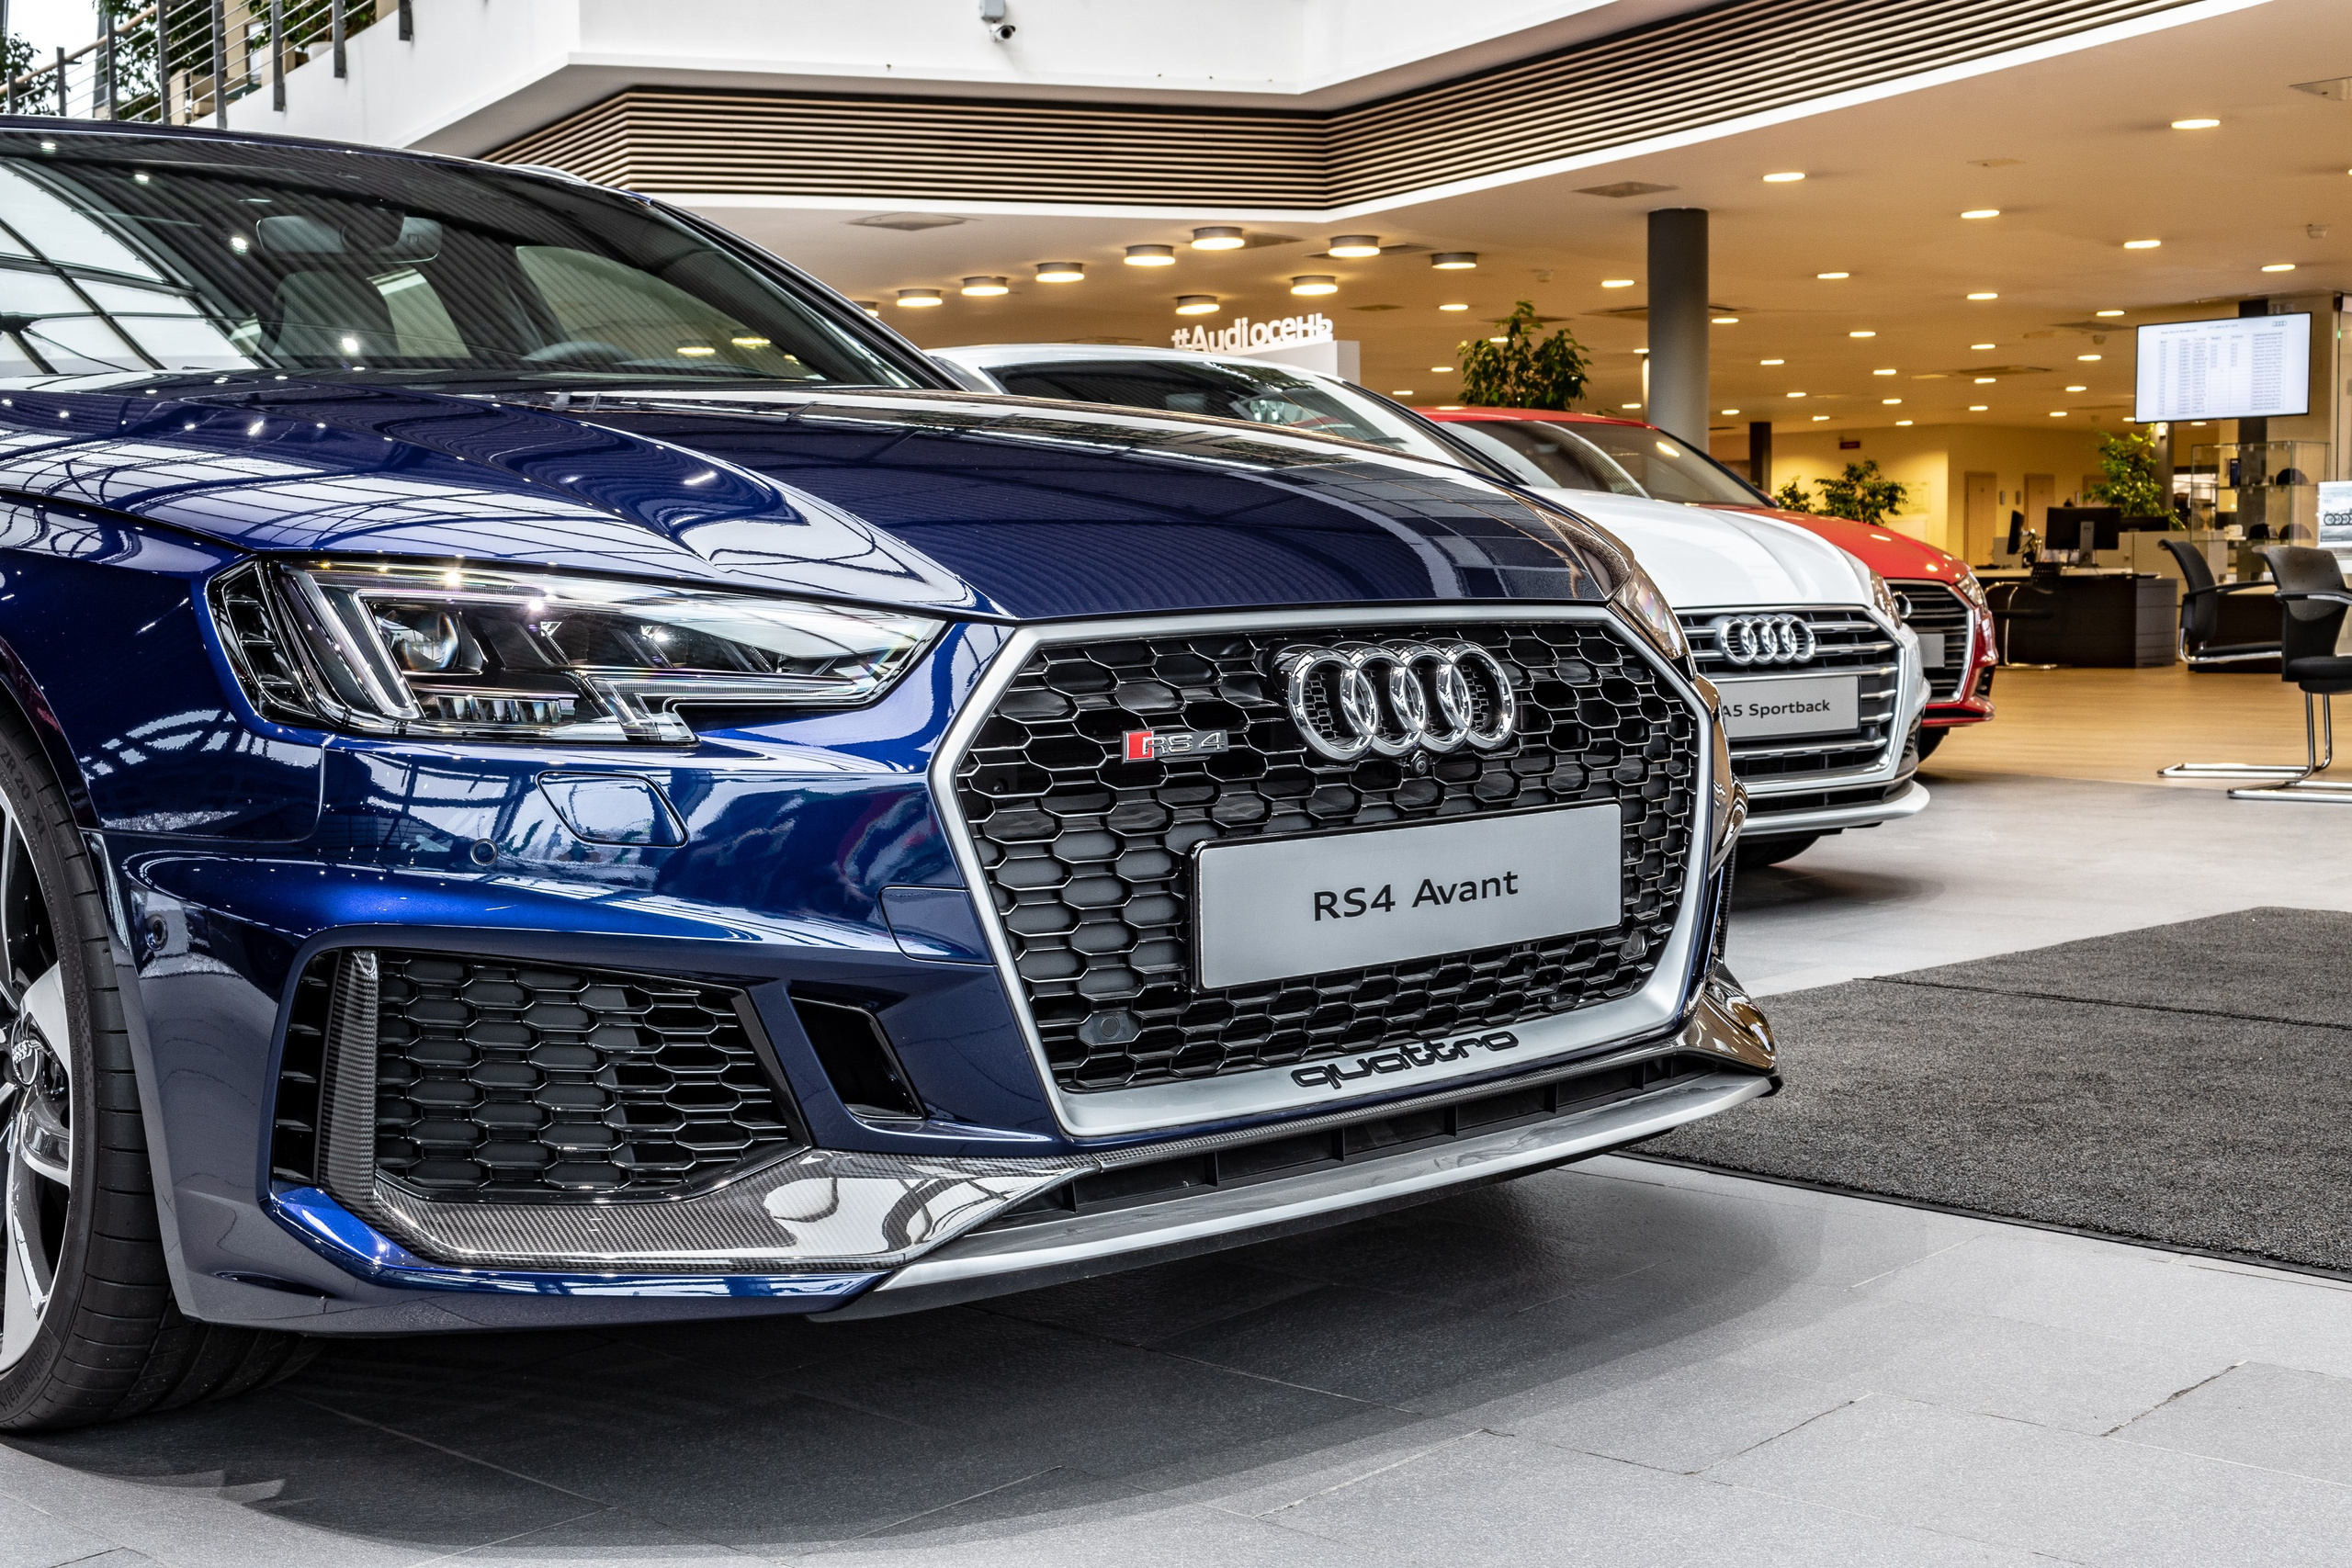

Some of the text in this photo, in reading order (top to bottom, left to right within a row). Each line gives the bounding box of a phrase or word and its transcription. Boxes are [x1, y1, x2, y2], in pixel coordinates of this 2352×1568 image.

[1723, 700, 1830, 718] A5 Sportback
[1314, 871, 1519, 921] RS4 Avant
[1291, 1031, 1519, 1089] quattro
